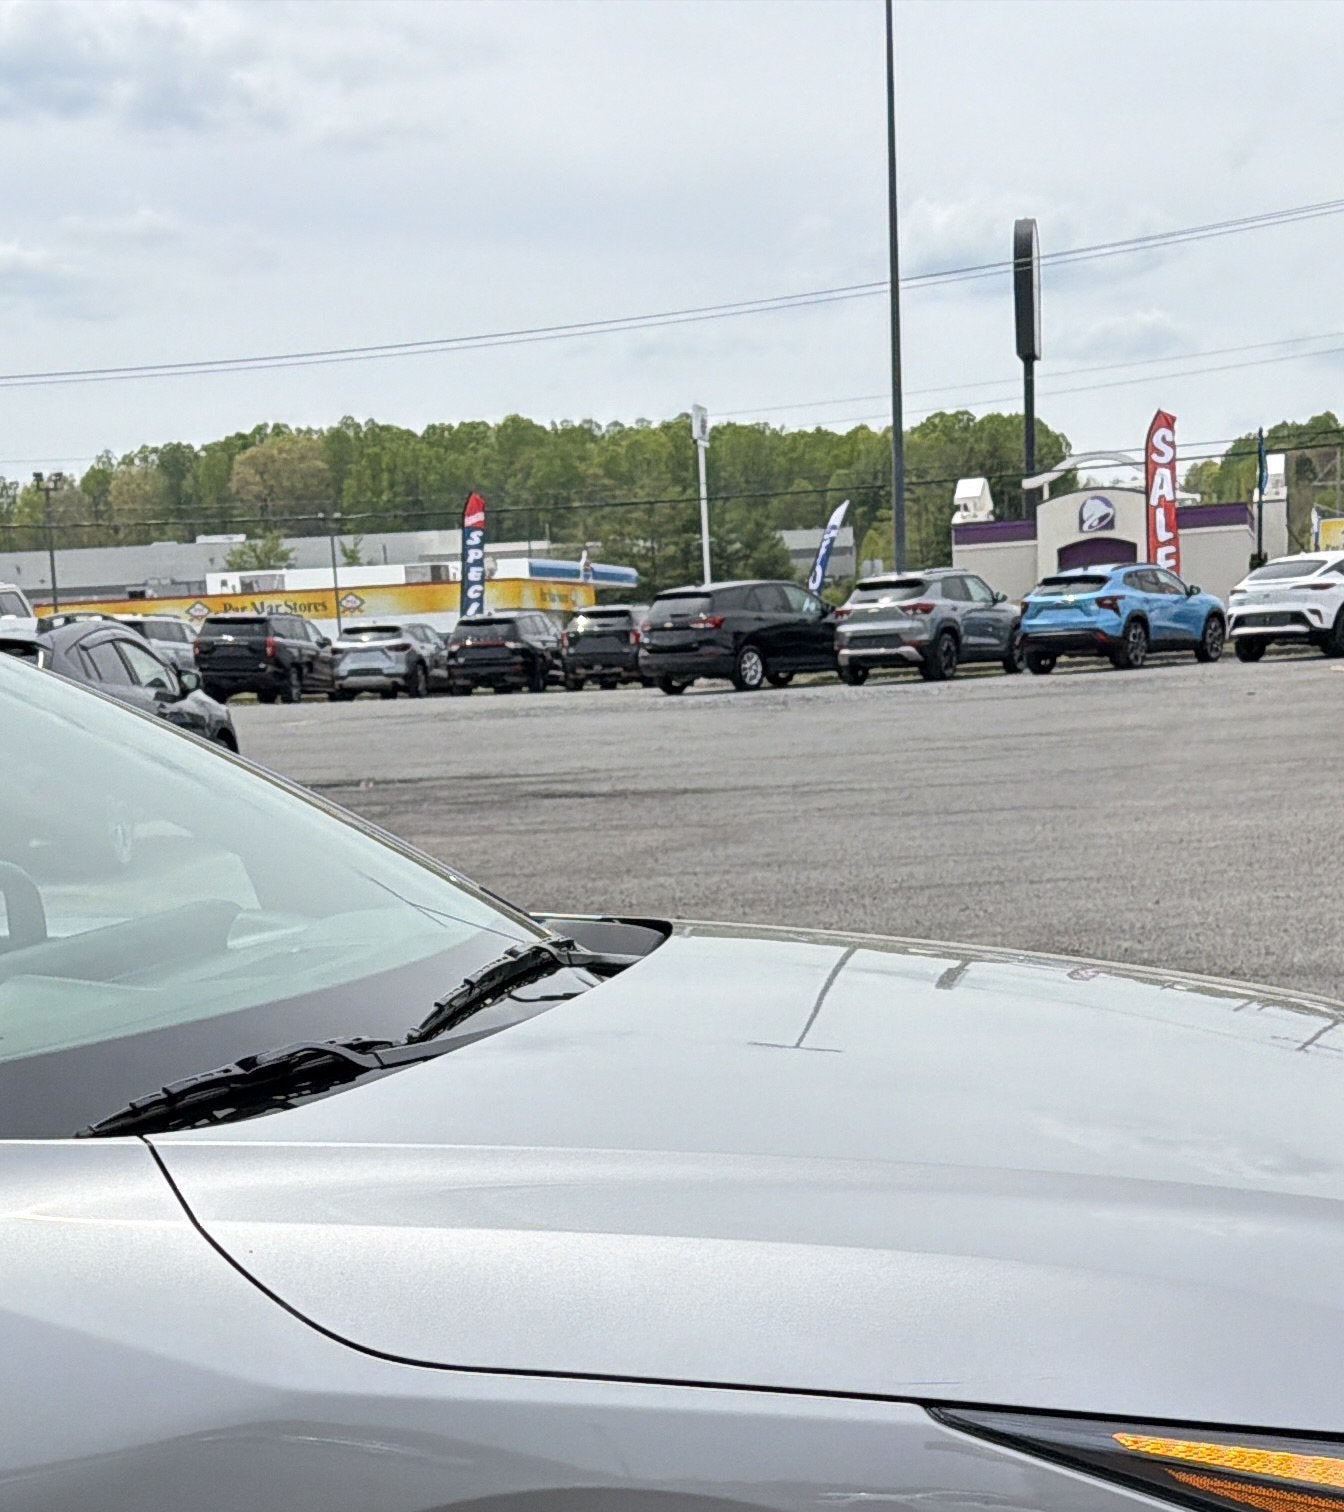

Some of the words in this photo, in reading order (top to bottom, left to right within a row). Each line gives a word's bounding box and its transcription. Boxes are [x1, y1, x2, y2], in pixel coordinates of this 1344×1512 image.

[1149, 427, 1177, 575] SALE
[251, 600, 283, 615] Mar
[284, 600, 328, 614] Stores
[466, 530, 484, 616] SPECI
